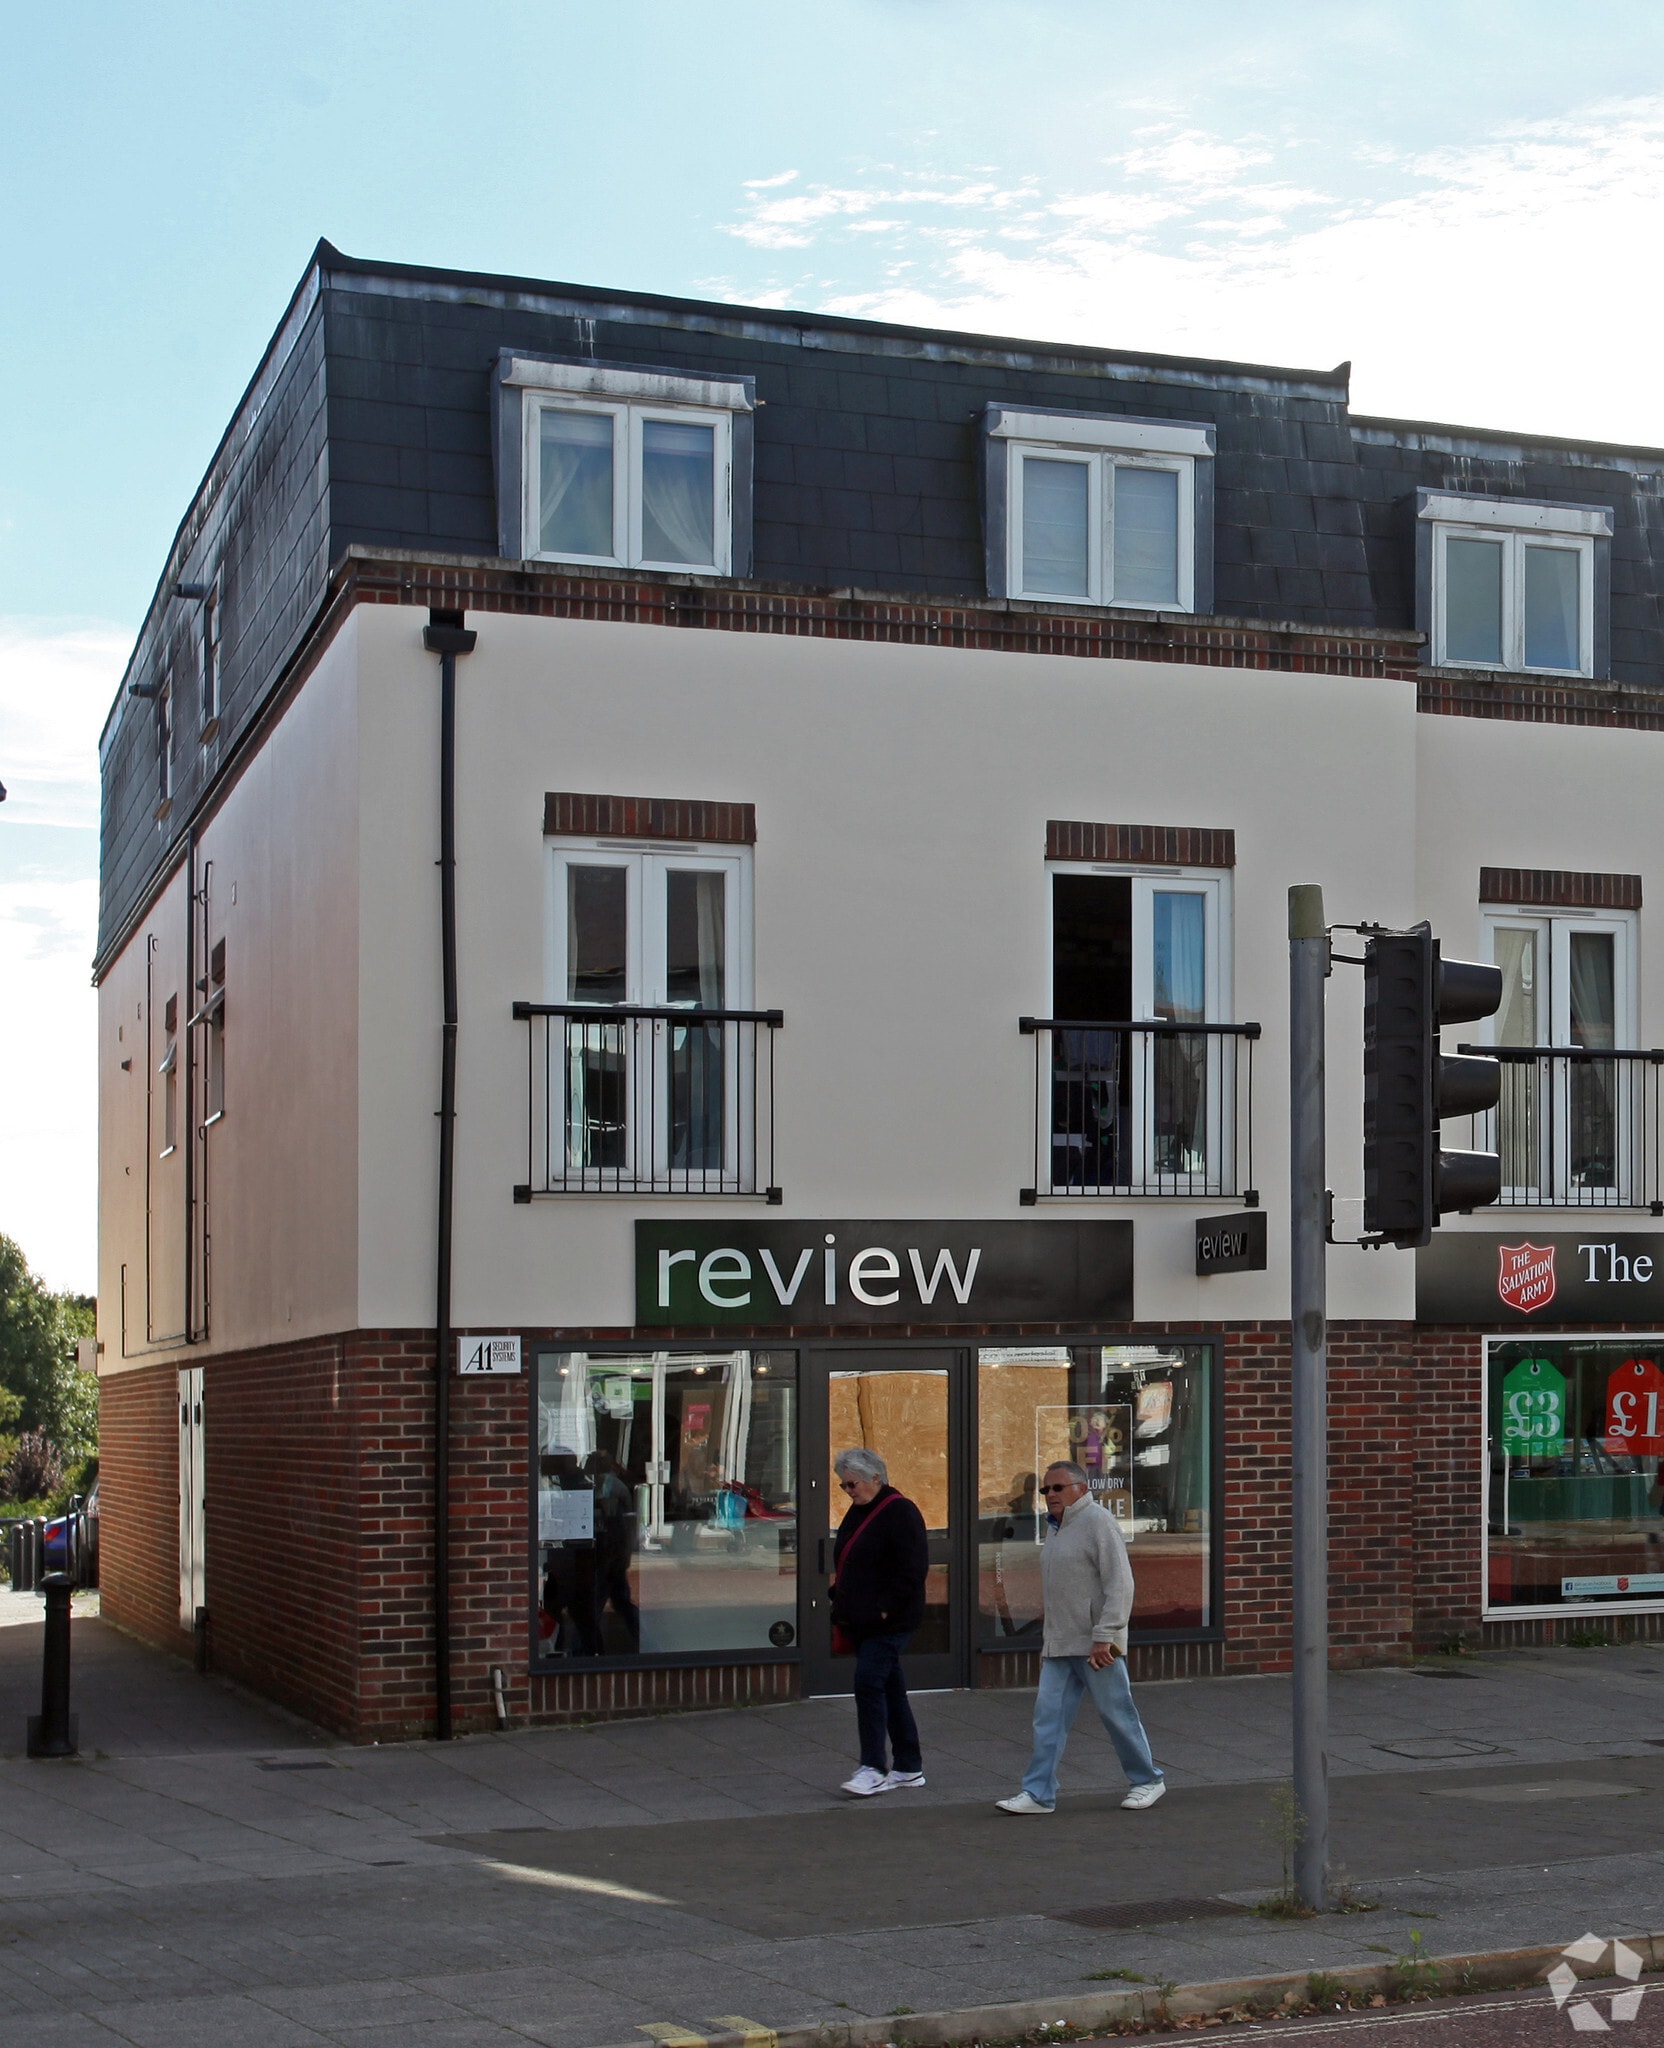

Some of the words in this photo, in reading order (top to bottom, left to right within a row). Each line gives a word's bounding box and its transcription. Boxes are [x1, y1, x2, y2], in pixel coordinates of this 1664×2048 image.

[1197, 1230, 1242, 1259] review
[1511, 1250, 1531, 1270] THE
[657, 1233, 981, 1308] review
[1502, 1255, 1551, 1295] SALVATION
[1577, 1243, 1653, 1283] The
[1519, 1276, 1549, 1304] ARMY
[465, 1341, 493, 1371] A1
[1505, 1391, 1561, 1439] £3
[1608, 1391, 1661, 1438] £1
[1087, 1478, 1106, 1490] LOW
[1107, 1477, 1124, 1489] DRY
